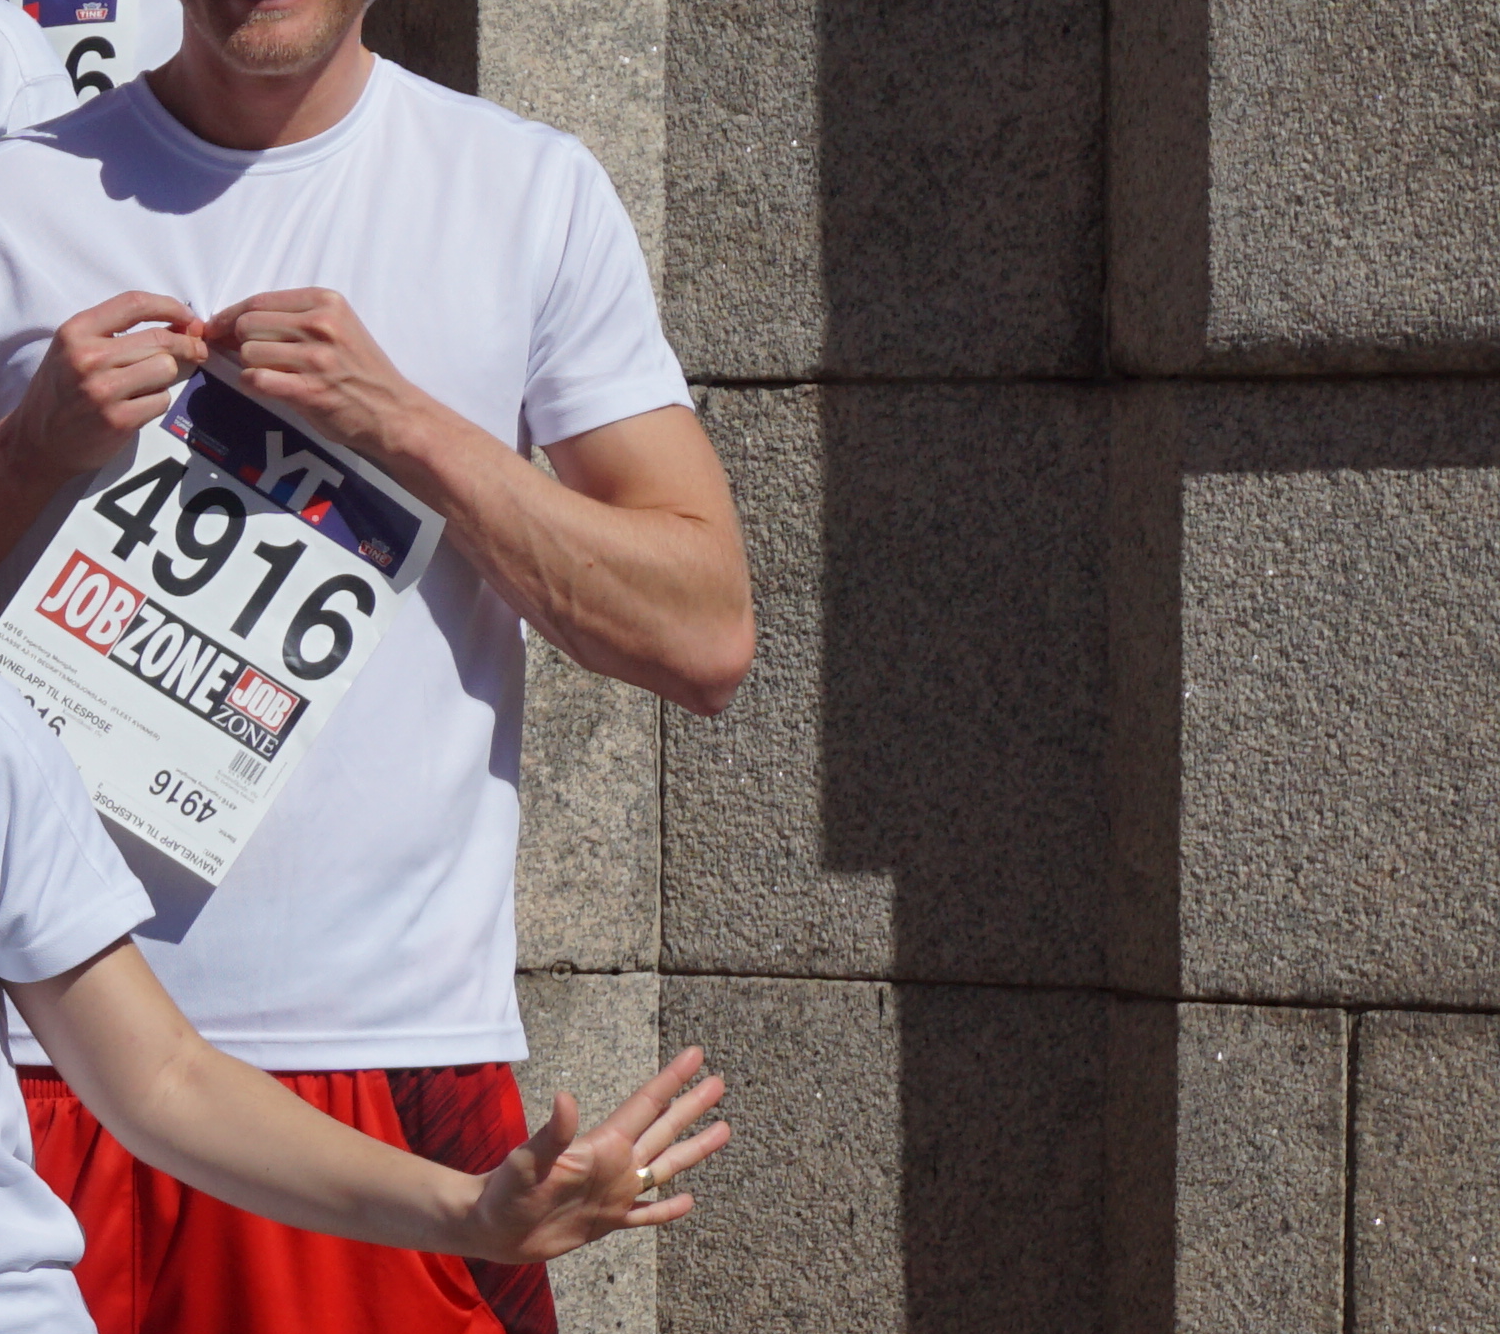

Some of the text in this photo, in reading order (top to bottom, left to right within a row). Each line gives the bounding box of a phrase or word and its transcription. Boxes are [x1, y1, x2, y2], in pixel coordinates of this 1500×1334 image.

[80, 10, 104, 19] TINE
[255, 430, 345, 511] YT
[93, 456, 376, 681] 4916
[363, 543, 389, 564] TINE
[3, 621, 24, 637] 4916
[46, 684, 60, 701] TIL
[60, 697, 113, 734] KLESPOSE
[231, 676, 293, 728] JOB
[212, 704, 279, 758] ZONE
[149, 769, 218, 823] 4916
[92, 790, 219, 877] NAVNELAPP TIL KLESPOSE
